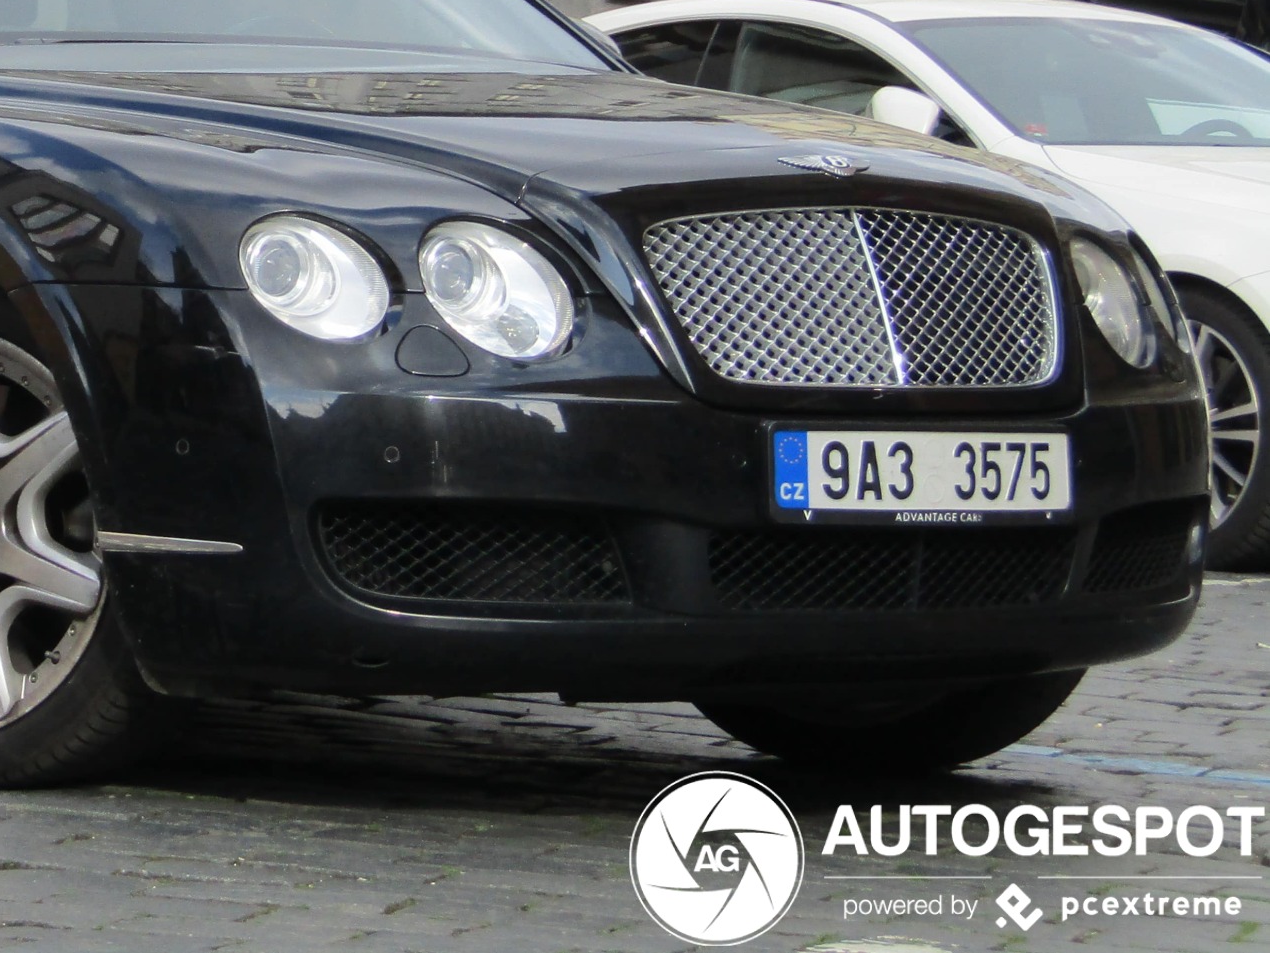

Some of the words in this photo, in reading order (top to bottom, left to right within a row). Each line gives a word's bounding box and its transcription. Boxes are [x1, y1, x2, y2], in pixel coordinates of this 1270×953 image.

[821, 440, 915, 501] 9A3
[953, 441, 1051, 501] 3575
[779, 482, 805, 500] CZ
[894, 512, 958, 523] ADVANTAGE
